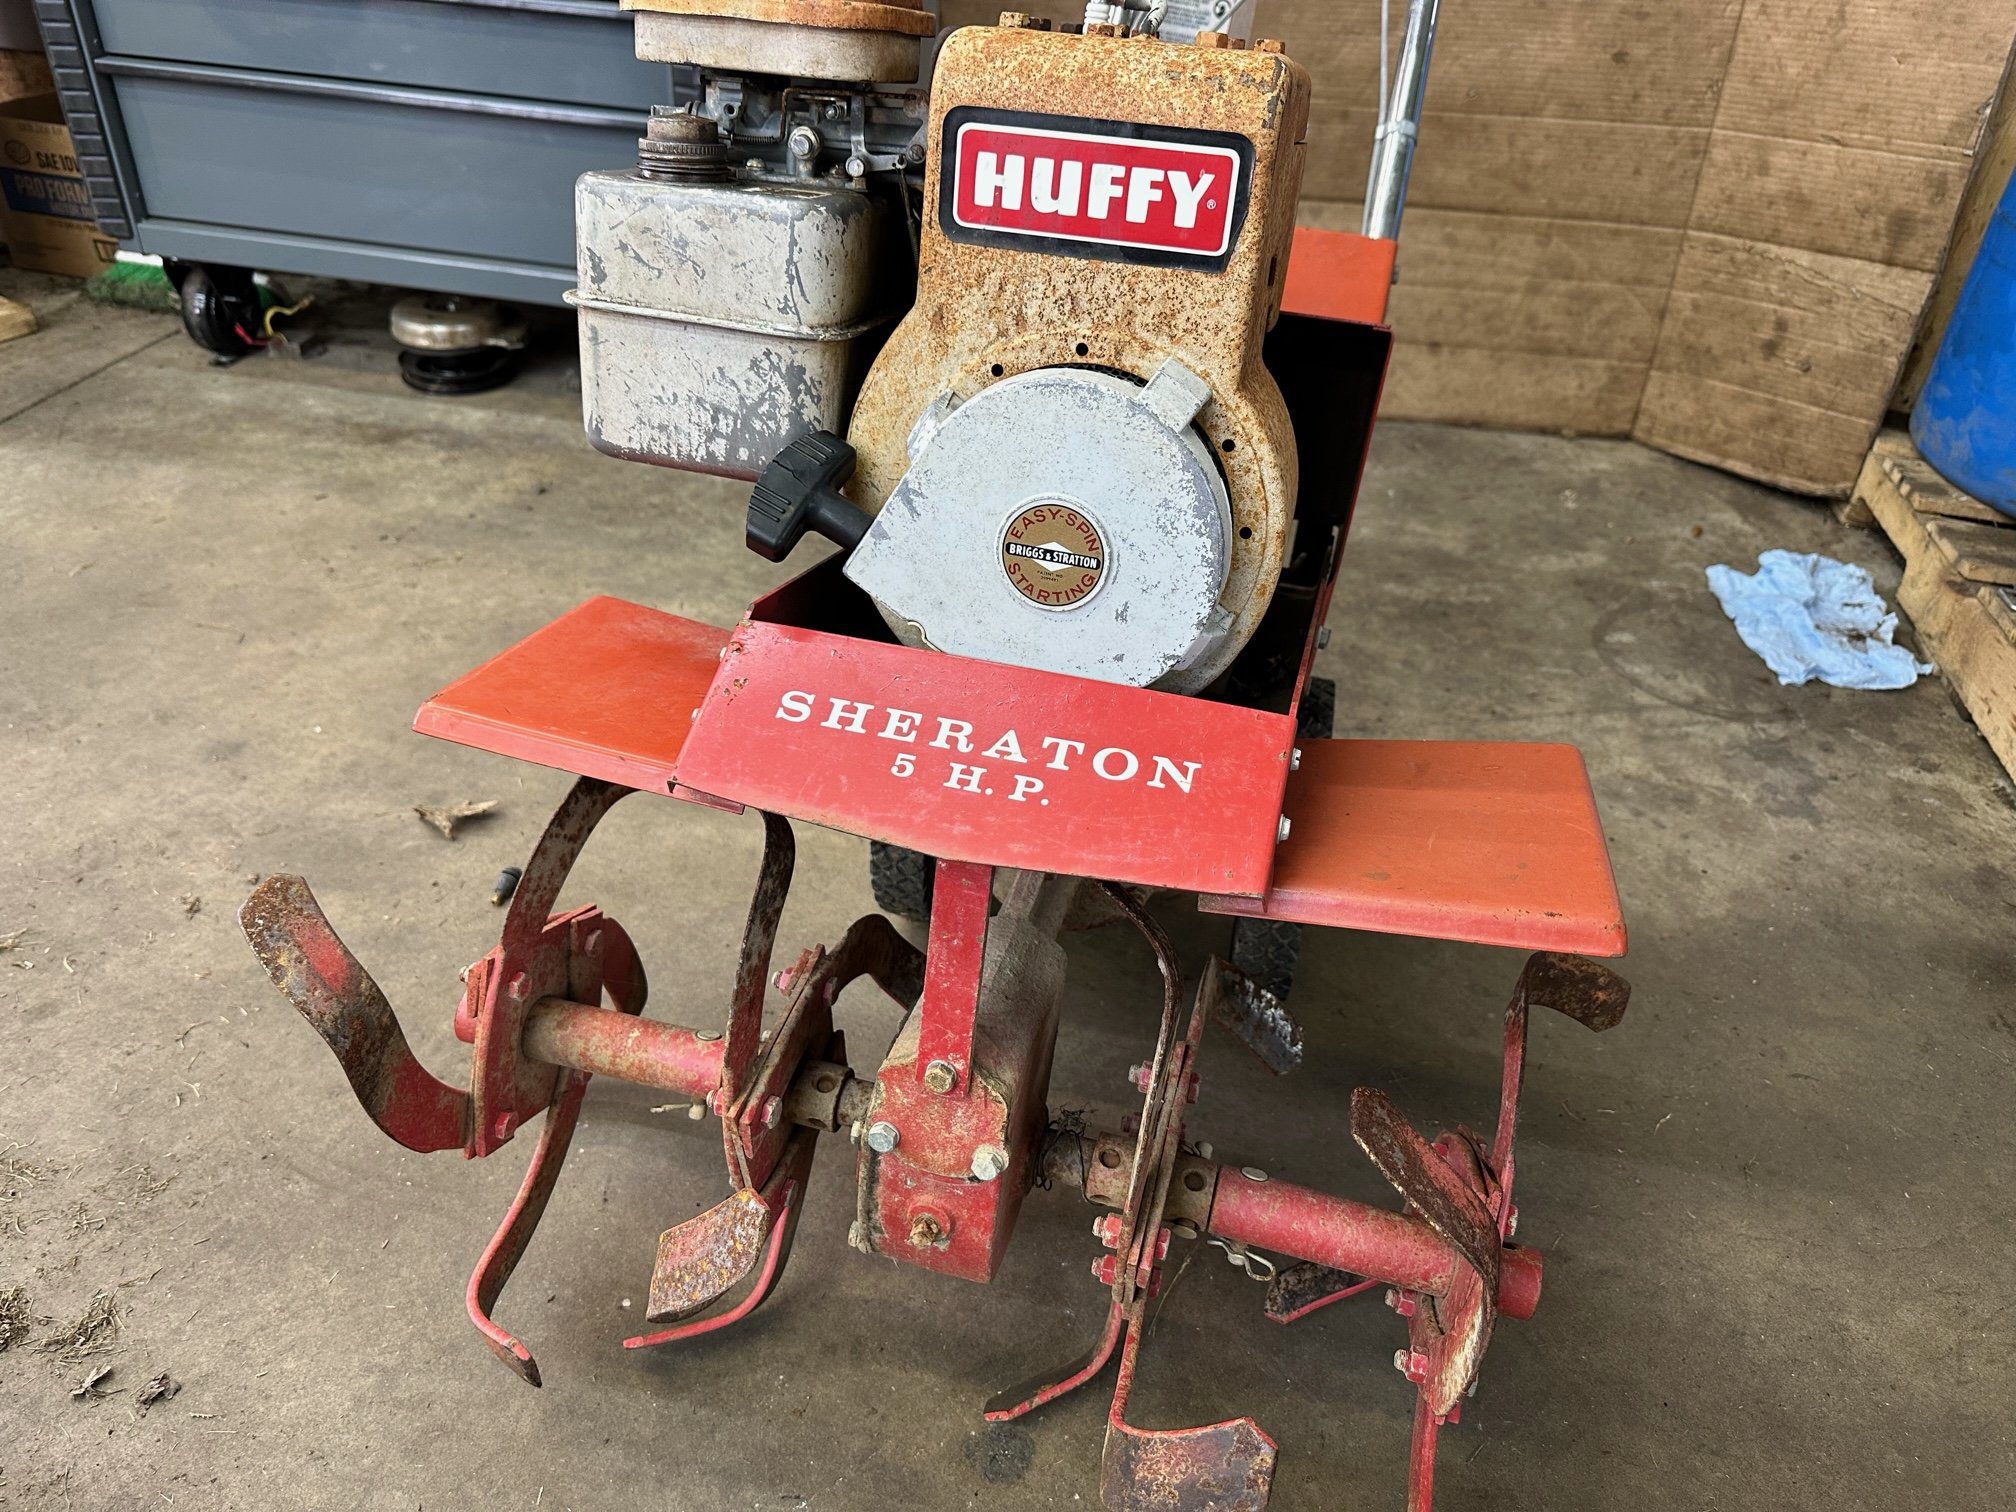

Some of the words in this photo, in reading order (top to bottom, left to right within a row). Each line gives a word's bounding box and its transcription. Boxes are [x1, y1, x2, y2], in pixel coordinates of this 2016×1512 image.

[37, 152, 60, 170] SAE
[1010, 508, 1100, 552] EASY-SPIN
[1009, 544, 1043, 560] BRIGGS
[1045, 552, 1052, 561] &
[1053, 551, 1098, 569] STRATTON
[1008, 562, 1096, 603] STARTING
[775, 690, 1203, 794] SHERATON
[890, 753, 917, 778] 5
